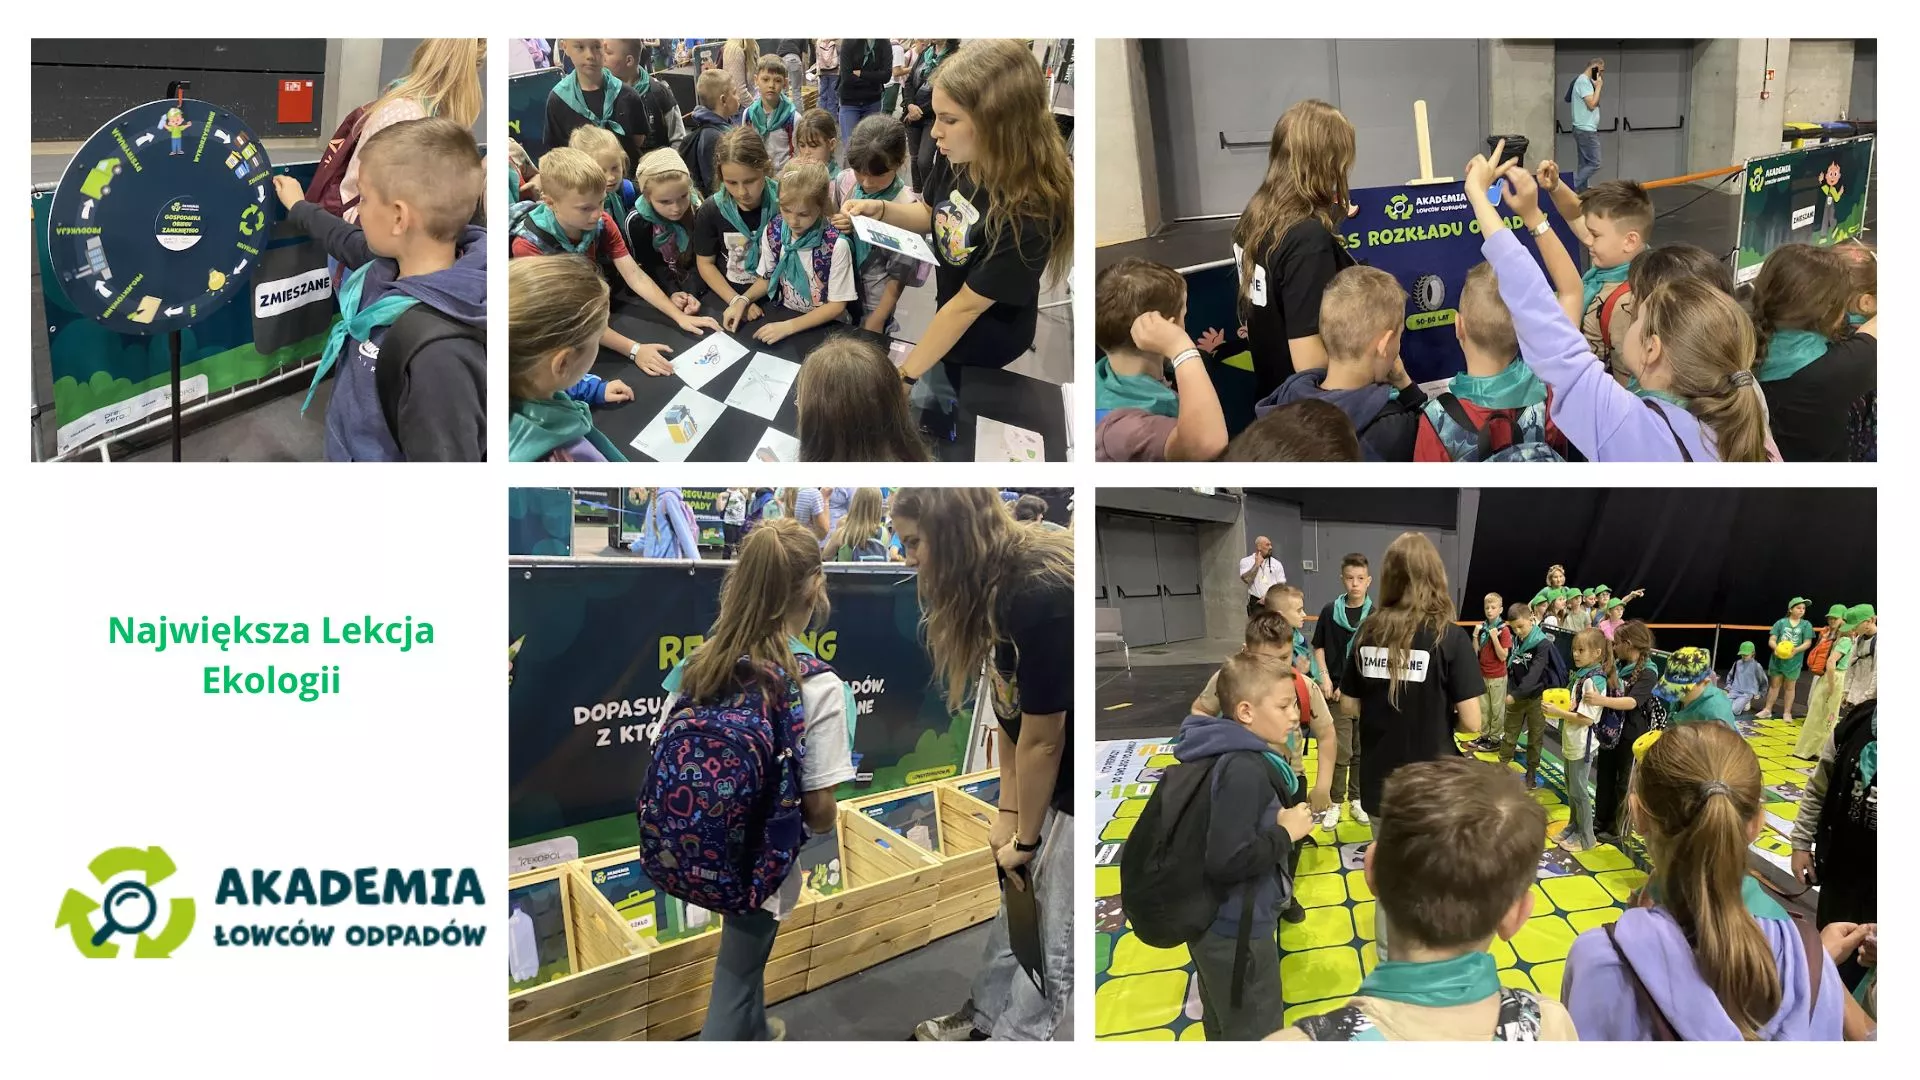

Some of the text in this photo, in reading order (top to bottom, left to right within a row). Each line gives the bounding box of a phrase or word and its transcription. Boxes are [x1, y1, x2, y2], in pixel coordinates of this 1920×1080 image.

[1415, 193, 1467, 206] AKADEMIA
[1368, 221, 1463, 247] ROZKŁADU
[260, 277, 330, 308] ZMIESZANE
[851, 674, 885, 695] DÓW,
[596, 727, 612, 747] Z
